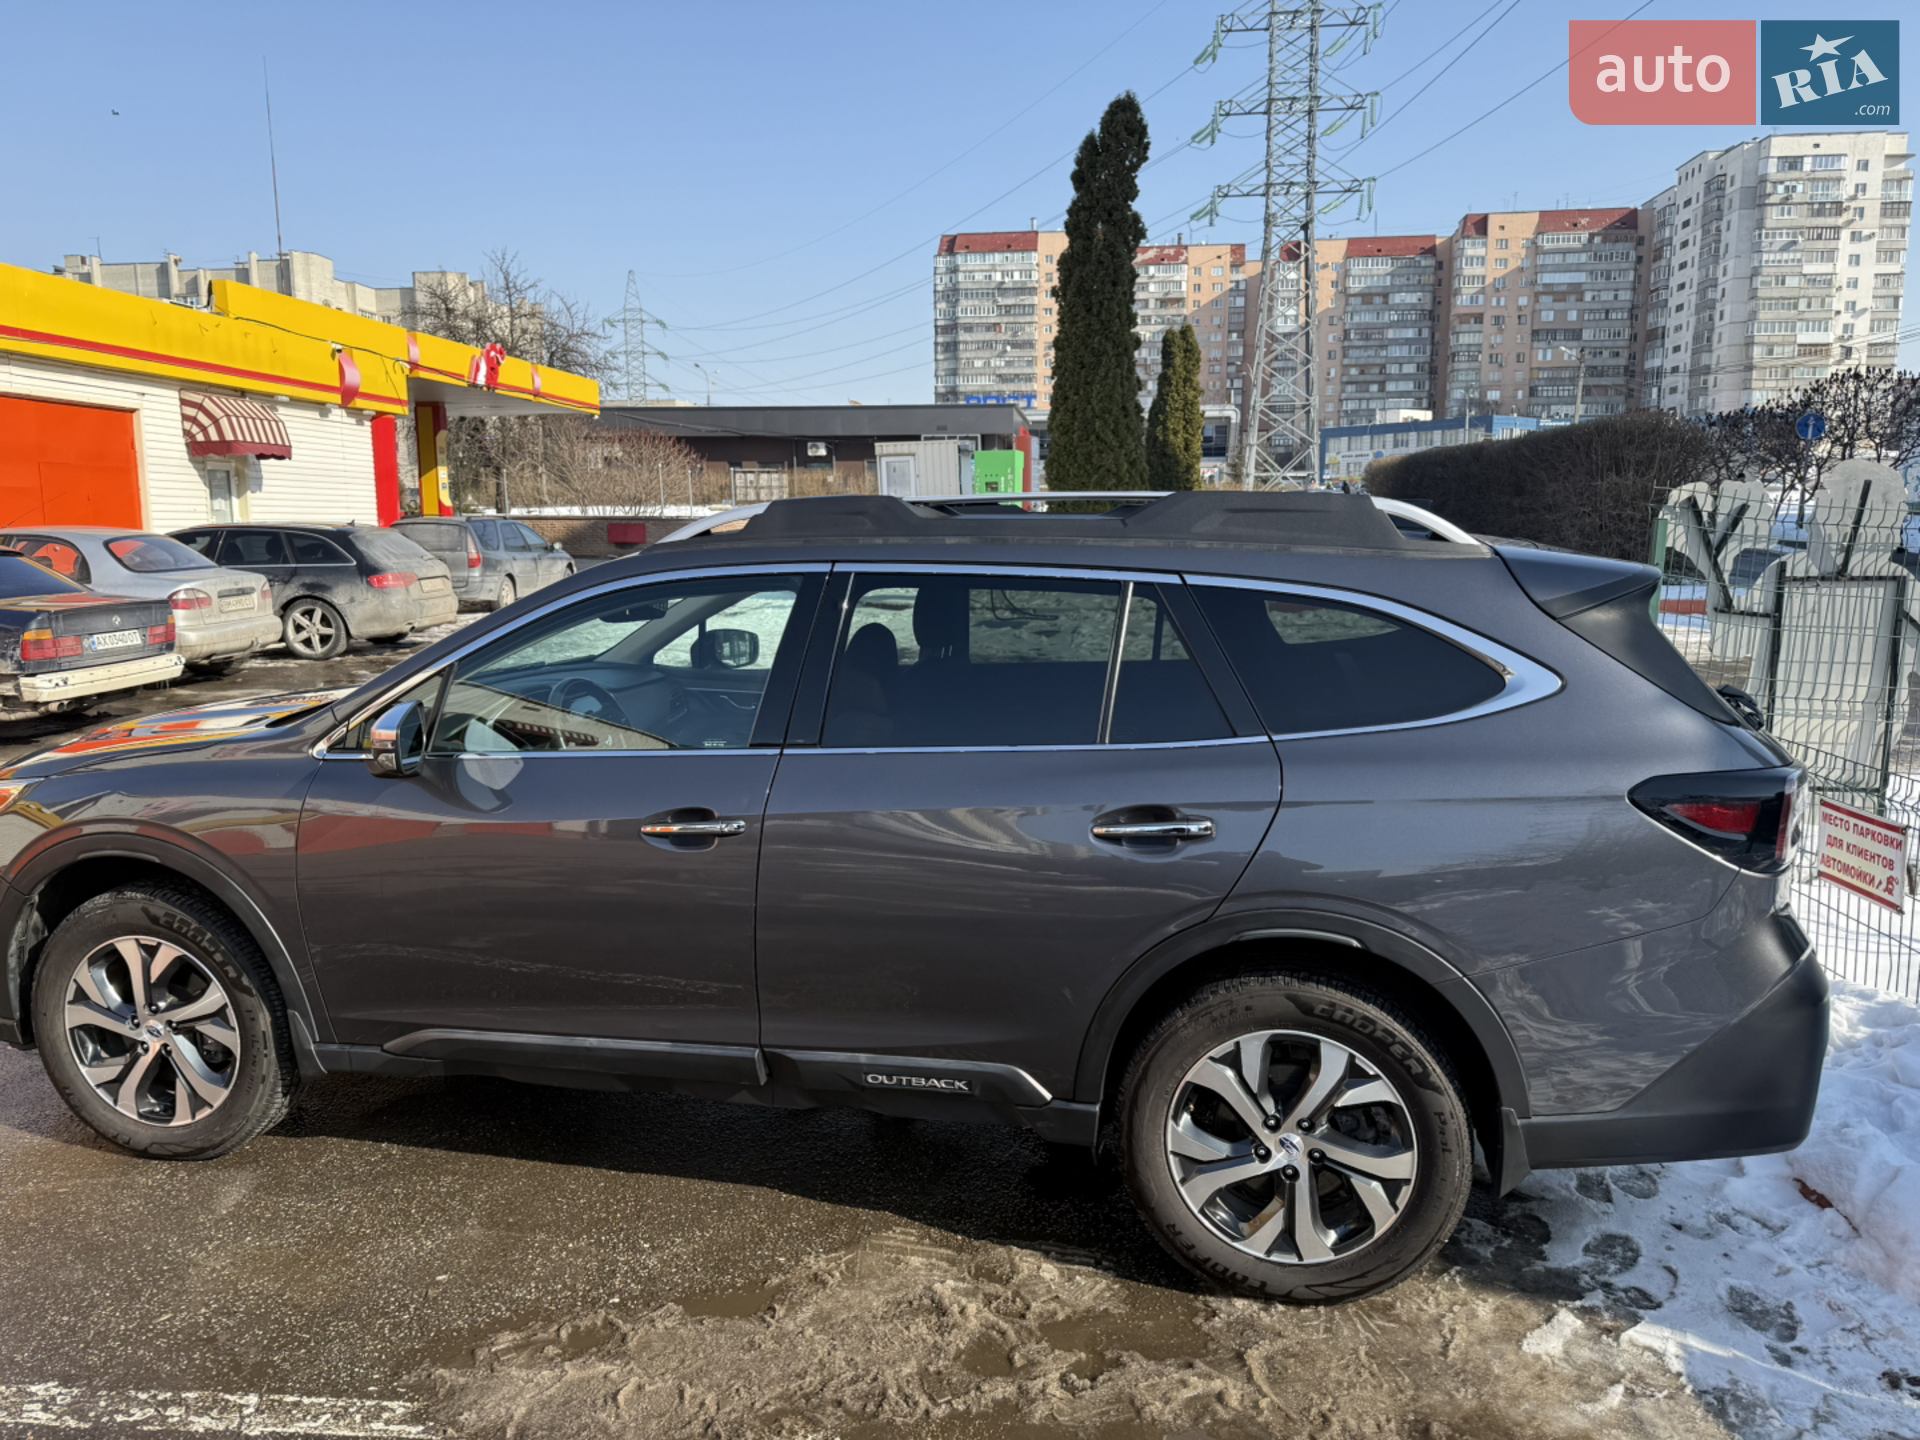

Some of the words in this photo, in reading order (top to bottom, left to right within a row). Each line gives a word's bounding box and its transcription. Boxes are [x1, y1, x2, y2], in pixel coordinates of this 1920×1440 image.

[1821, 811, 1850, 832] МЕСТО
[1853, 823, 1903, 852] ПАРКОВКИ
[1820, 853, 1876, 888] АВТОМОЙКИ
[1826, 834, 1843, 850] ДЛЯ
[1846, 841, 1895, 871] КЛИЕНТОВ
[1312, 1003, 1424, 1075] COOPER
[866, 1073, 969, 1091] OUTBACK
